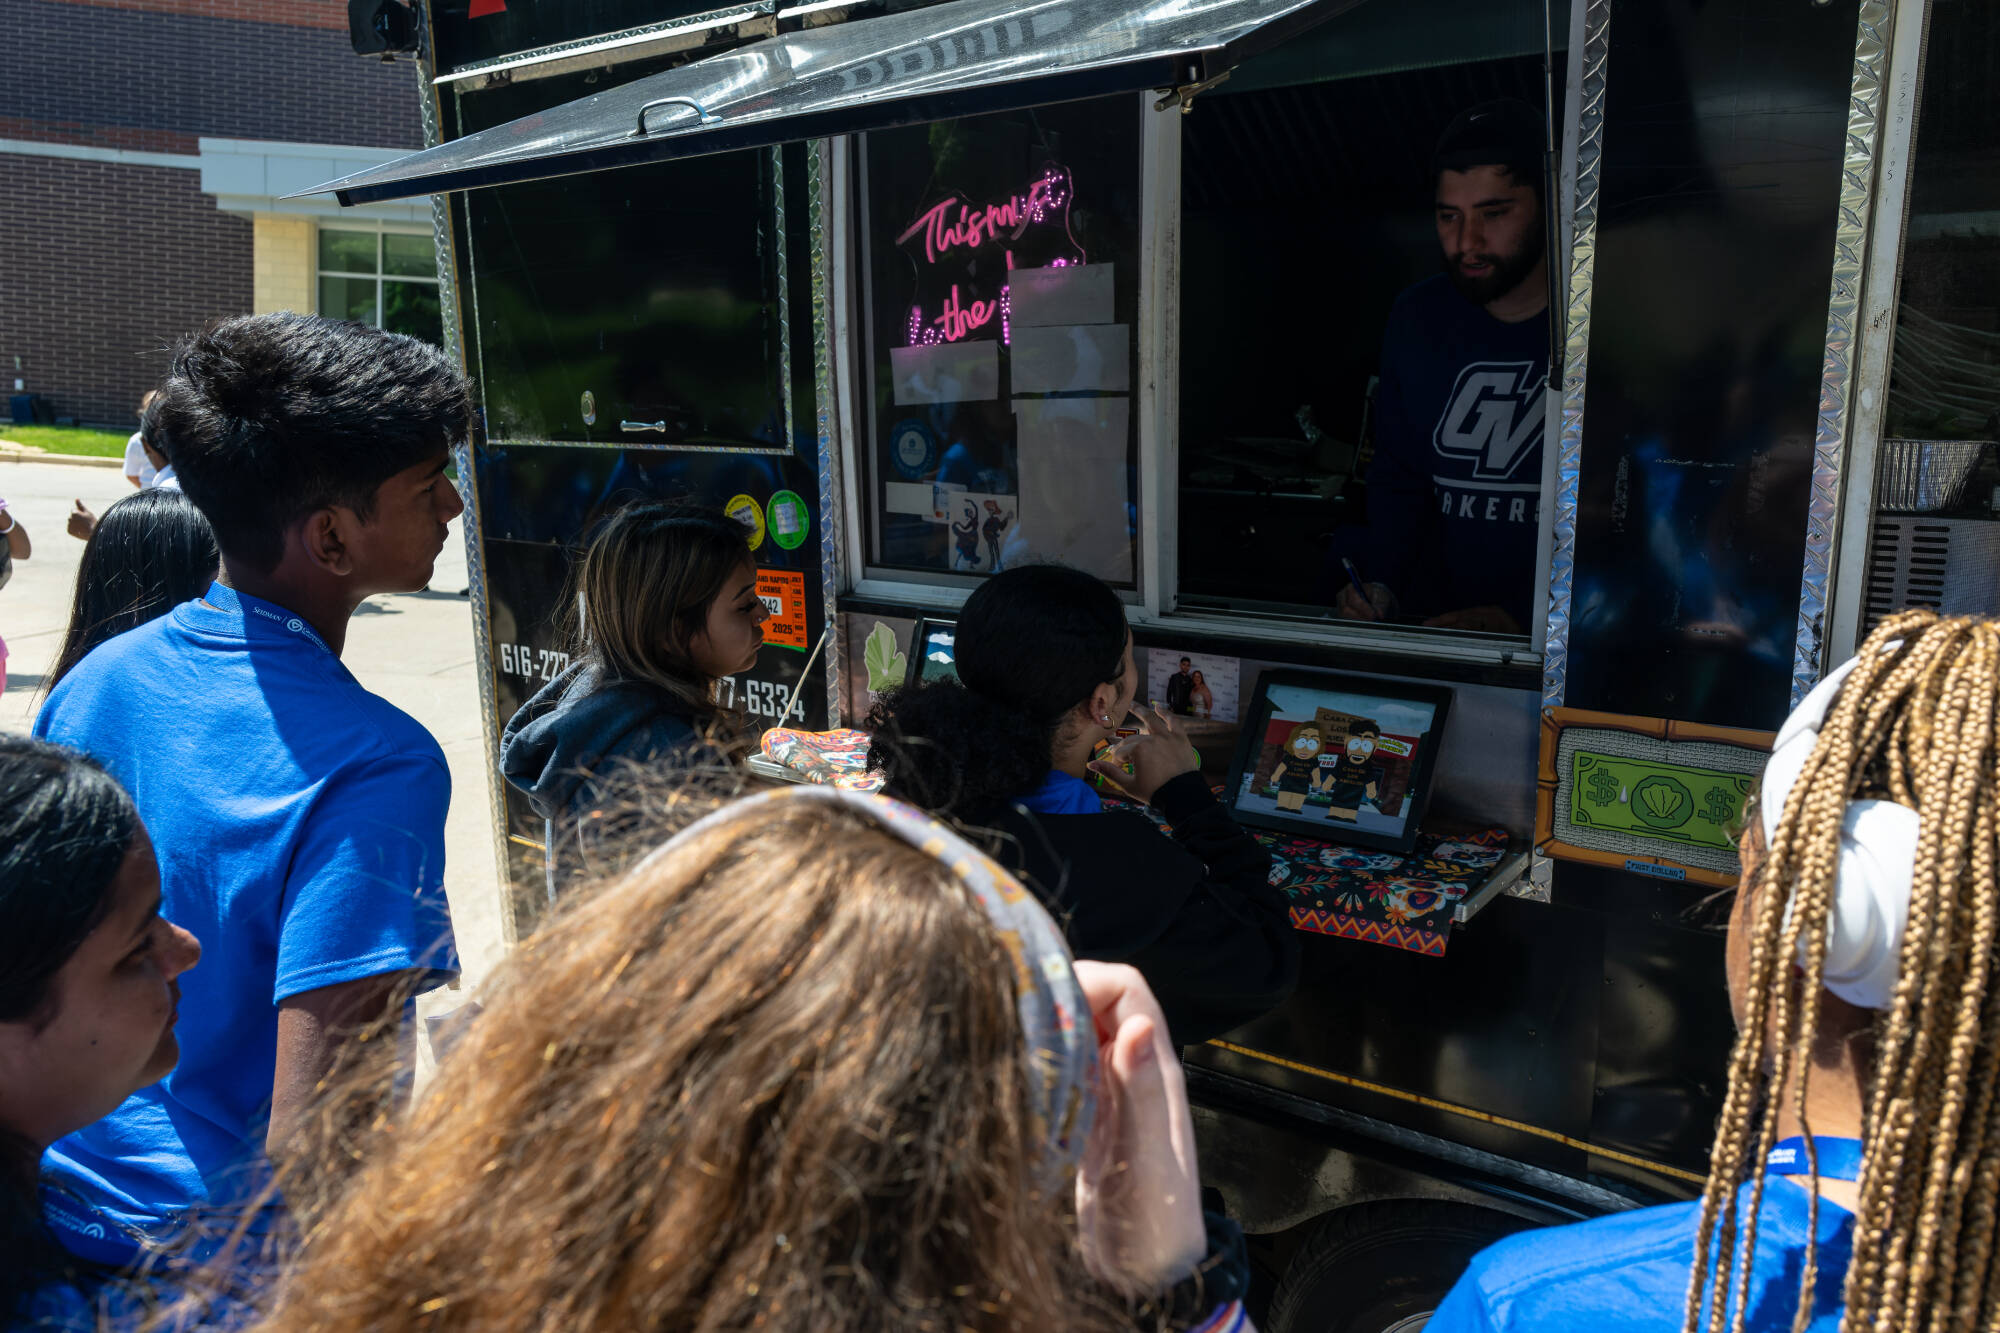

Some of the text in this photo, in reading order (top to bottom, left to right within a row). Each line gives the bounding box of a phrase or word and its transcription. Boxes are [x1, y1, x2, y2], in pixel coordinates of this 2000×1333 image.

[1433, 486, 1541, 523] AKER
[759, 585, 782, 594] LICENSE
[772, 623, 793, 635] 2025
[500, 643, 570, 683] 616-227
[715, 675, 806, 723] 77-6334
[1651, 865, 1679, 878] DOLLAR
